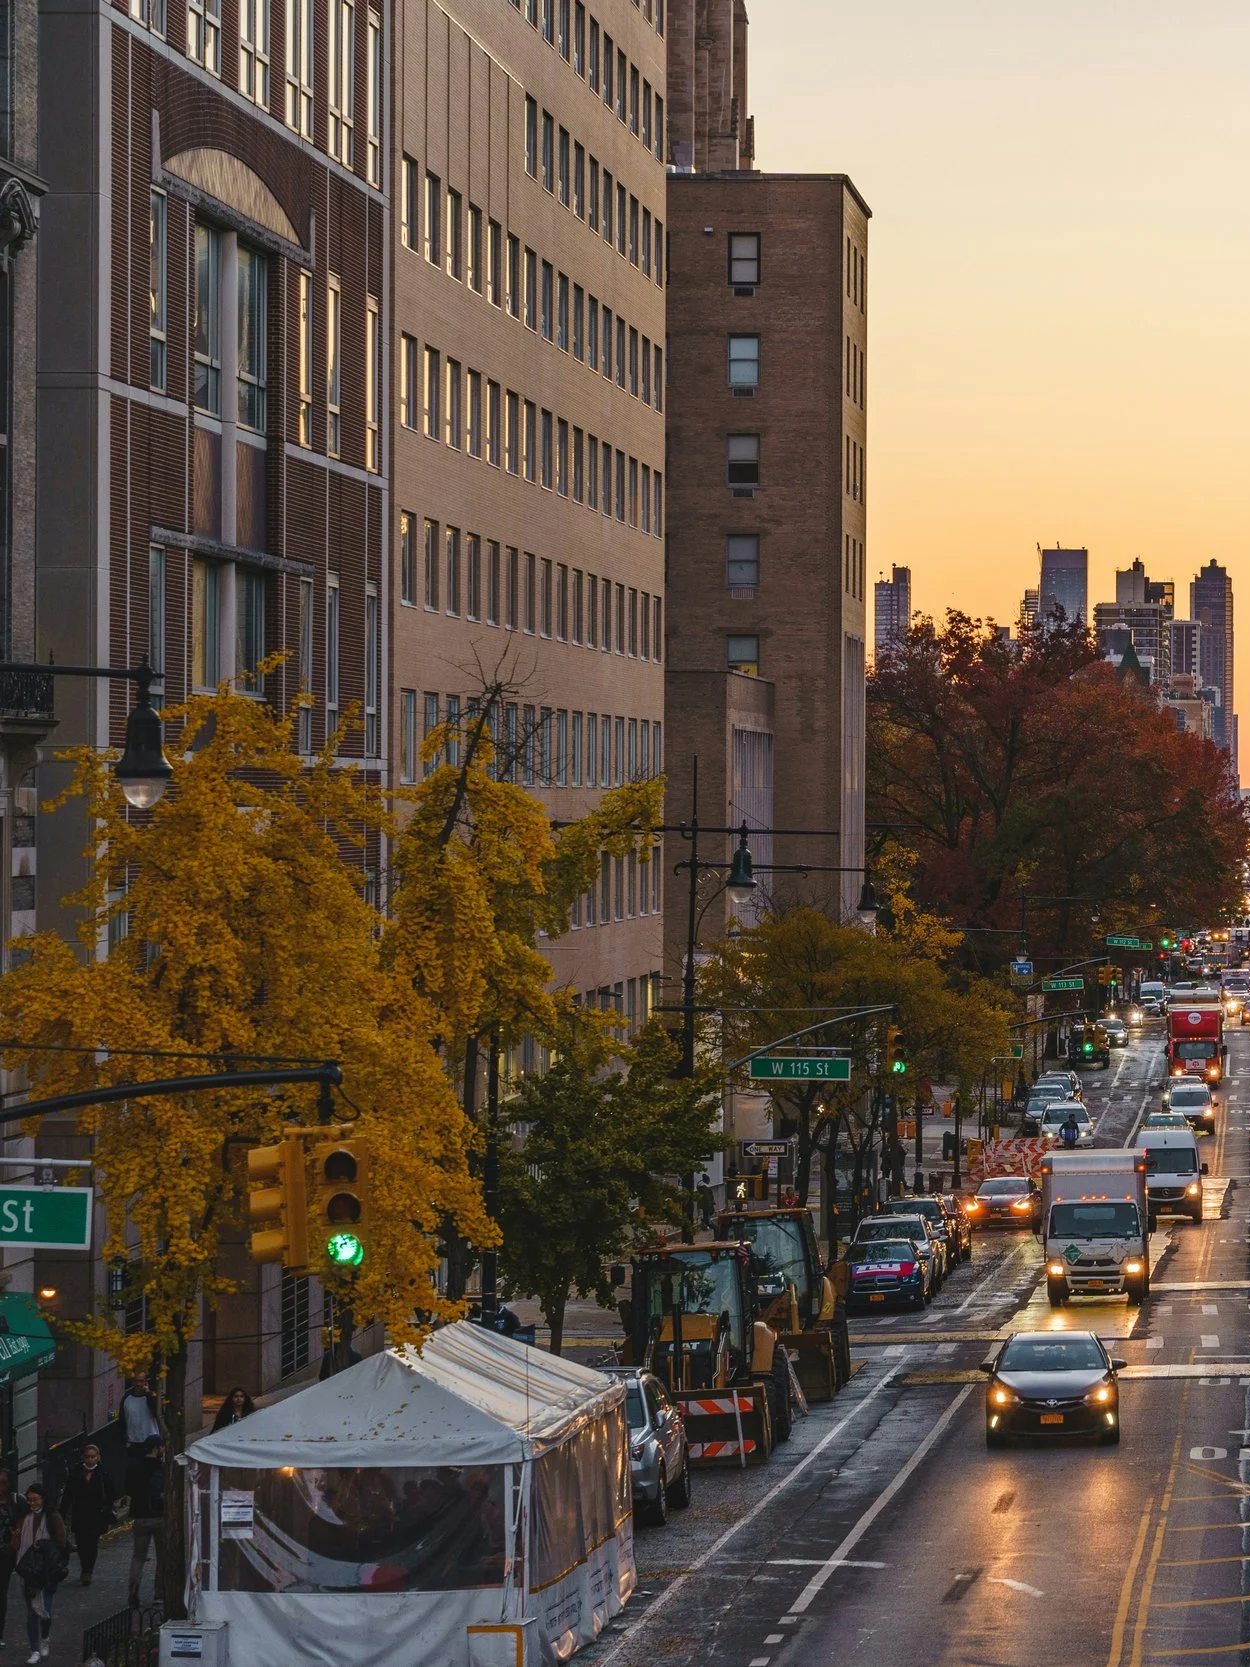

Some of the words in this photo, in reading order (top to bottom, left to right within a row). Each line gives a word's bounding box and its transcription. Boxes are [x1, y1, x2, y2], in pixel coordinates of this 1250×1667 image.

[771, 1062, 784, 1075] W
[790, 1062, 810, 1075] 115
[816, 1061, 829, 1076] St
[1, 1199, 35, 1233] St
